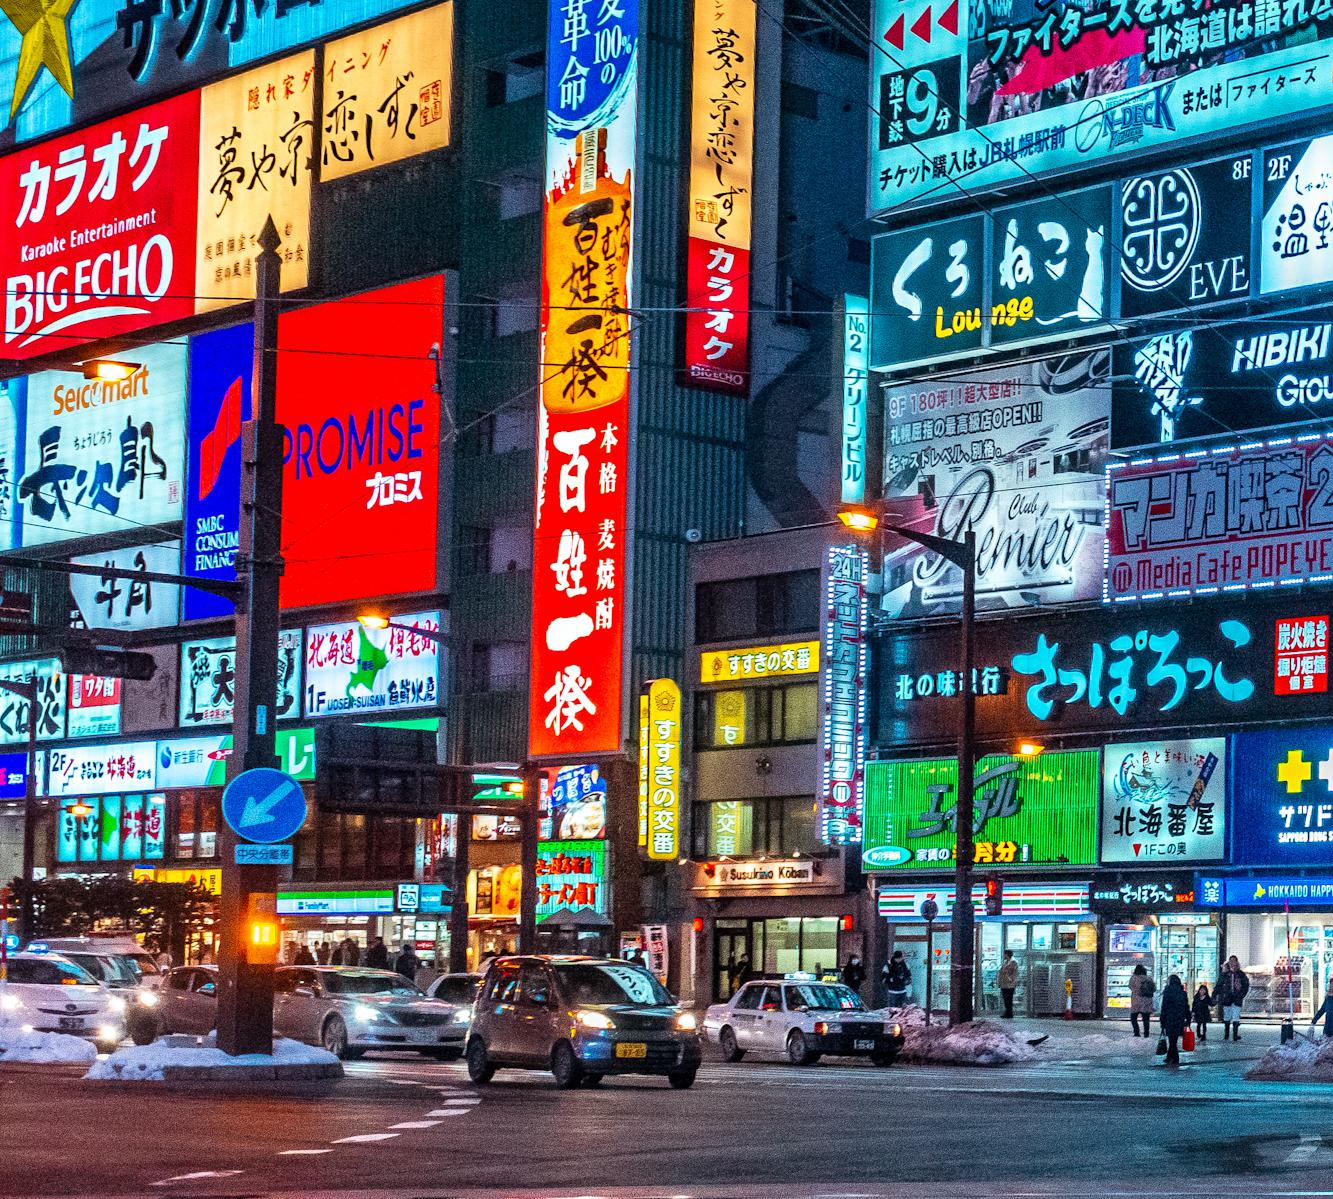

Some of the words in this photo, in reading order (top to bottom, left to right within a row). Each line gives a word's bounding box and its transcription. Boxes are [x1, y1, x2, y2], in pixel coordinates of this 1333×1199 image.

[247, 38, 392, 111] 隠れ家ダイニング
[1231, 68, 1318, 103] ファイターズ
[888, 75, 906, 144] 地下鉄
[1182, 91, 1224, 116] または
[14, 123, 168, 228] カラオケ
[1232, 158, 1251, 180] 8F
[1268, 155, 1291, 181] 2F
[20, 227, 67, 264] Karaoke
[69, 208, 157, 248] Entertainment
[891, 218, 1070, 322] くろねこ
[1189, 255, 1249, 300] EVE
[4, 260, 70, 345] BIG
[73, 232, 174, 309] ECHO
[560, 196, 615, 405] 百姓一揆
[703, 247, 735, 362] カラオケ
[935, 296, 1034, 340] Lounge
[1231, 323, 1332, 373] HIBIKI
[690, 362, 712, 380] BIG
[712, 367, 744, 386] ECHO
[843, 366, 868, 484] グリーンビル
[889, 396, 907, 420] 9F
[73, 428, 113, 451] ちょうじろう
[283, 399, 425, 481] PROMISE
[18, 414, 168, 523] 長次郎
[598, 421, 618, 496] 本格
[364, 470, 424, 510] プロミス
[1008, 493, 1039, 521] Club
[196, 514, 225, 537] SMBC
[196, 530, 240, 553] CONSUM
[195, 549, 237, 571] FINANC
[595, 518, 616, 631] 麦焼酎
[1136, 555, 1192, 593] Media
[1197, 551, 1242, 587] Cafe
[1248, 538, 1332, 581] POPEYE
[94, 550, 153, 619] 牛角
[543, 426, 598, 737] 百姓一揆
[308, 628, 356, 669] 北海道
[1276, 618, 1328, 650] 炭火焼き
[728, 645, 812, 672] すすきの交番
[1012, 620, 1255, 721] さっぽろっこ
[1276, 652, 1328, 678] 掘り炬燵
[307, 684, 326, 714] 1F
[1289, 673, 1315, 693] 個室
[327, 693, 387, 712] UOSEN-SUISAN
[52, 752, 66, 772] 2F
[653, 718, 677, 855] すすきの交番
[1113, 803, 1216, 838] 北海番屋
[1277, 831, 1307, 843] SAPPORO
[1308, 831, 1325, 842] DRUG
[1144, 842, 1187, 856] 1Fこの奥
[729, 866, 775, 882] Susukino
[1268, 884, 1309, 898] HOKKAIDO
[1120, 883, 1174, 904] さっぽろっこ
